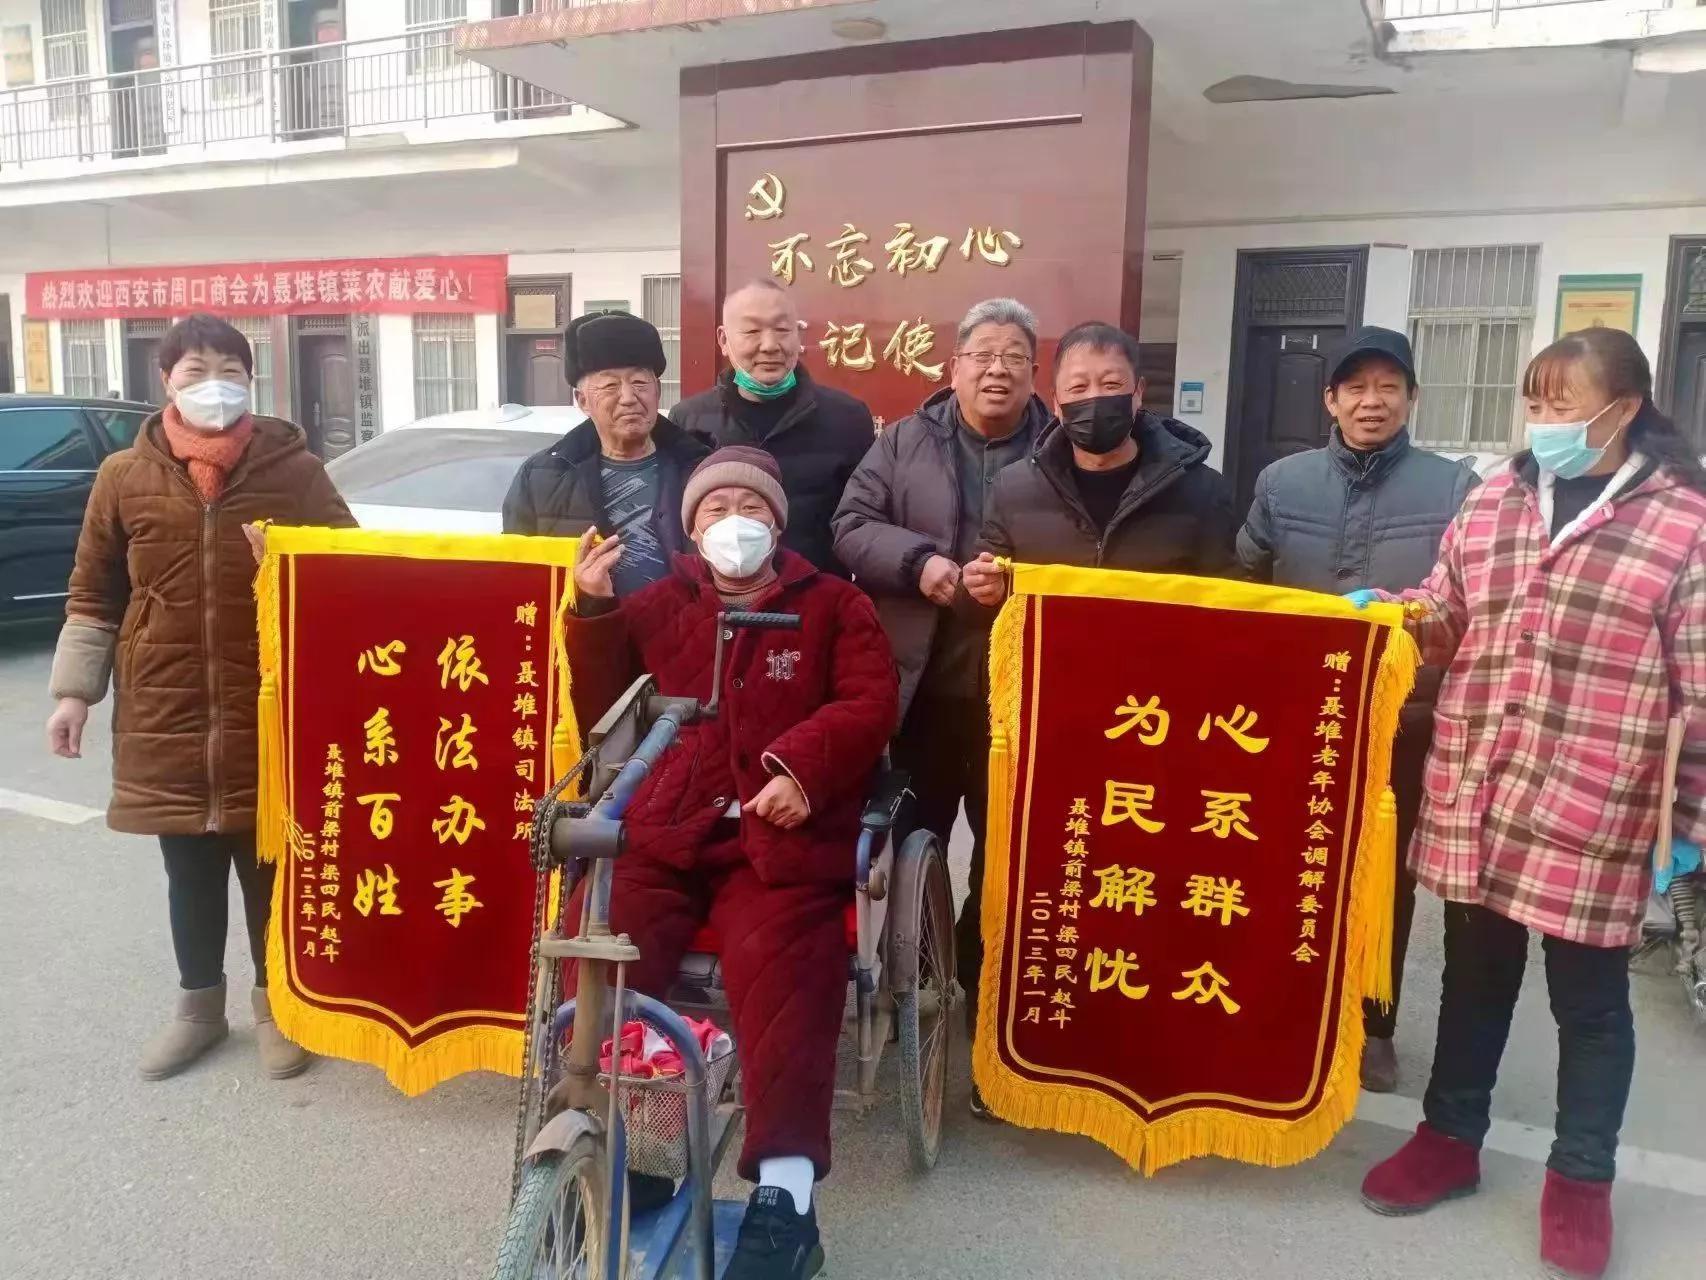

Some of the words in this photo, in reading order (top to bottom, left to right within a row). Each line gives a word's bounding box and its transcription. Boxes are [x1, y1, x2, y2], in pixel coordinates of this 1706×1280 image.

[768, 223, 1023, 287] 不忘初心
[353, 640, 406, 917] 心系百姓
[432, 635, 489, 928] 依法办事
[512, 601, 539, 840] 赠：聂堆镇司法所
[1084, 695, 1170, 999] 为民解忧
[1171, 704, 1270, 1014] 心系群众
[1291, 651, 1351, 963] 赠：聂堆老年协会调解委员会
